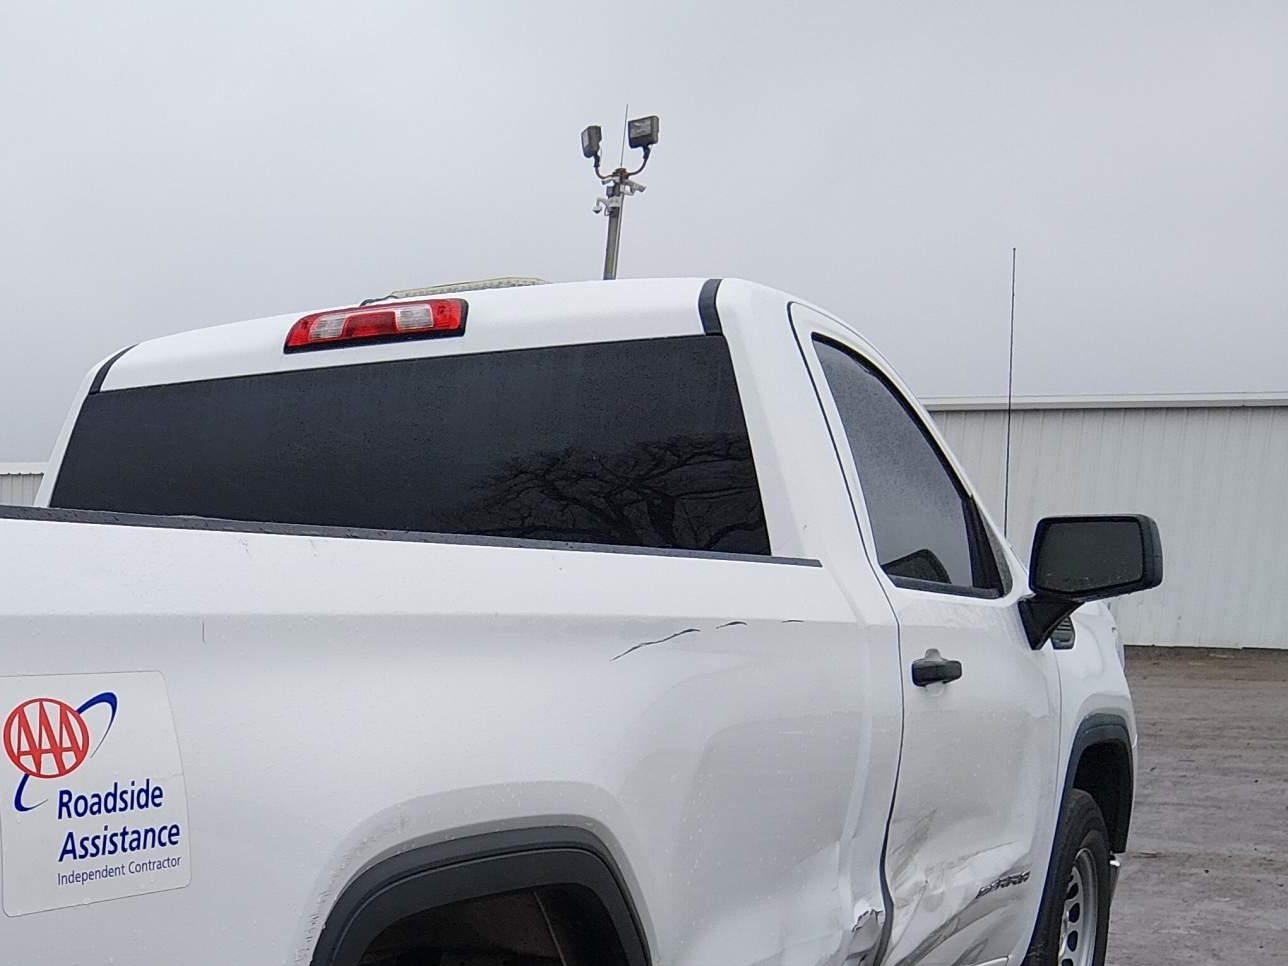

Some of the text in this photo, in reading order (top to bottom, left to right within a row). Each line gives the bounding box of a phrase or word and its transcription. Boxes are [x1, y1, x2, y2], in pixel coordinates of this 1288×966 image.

[6, 699, 86, 777] AAA
[57, 778, 164, 819] Roadside
[58, 823, 180, 862] Assistance
[57, 855, 182, 886] Independent Contractor
